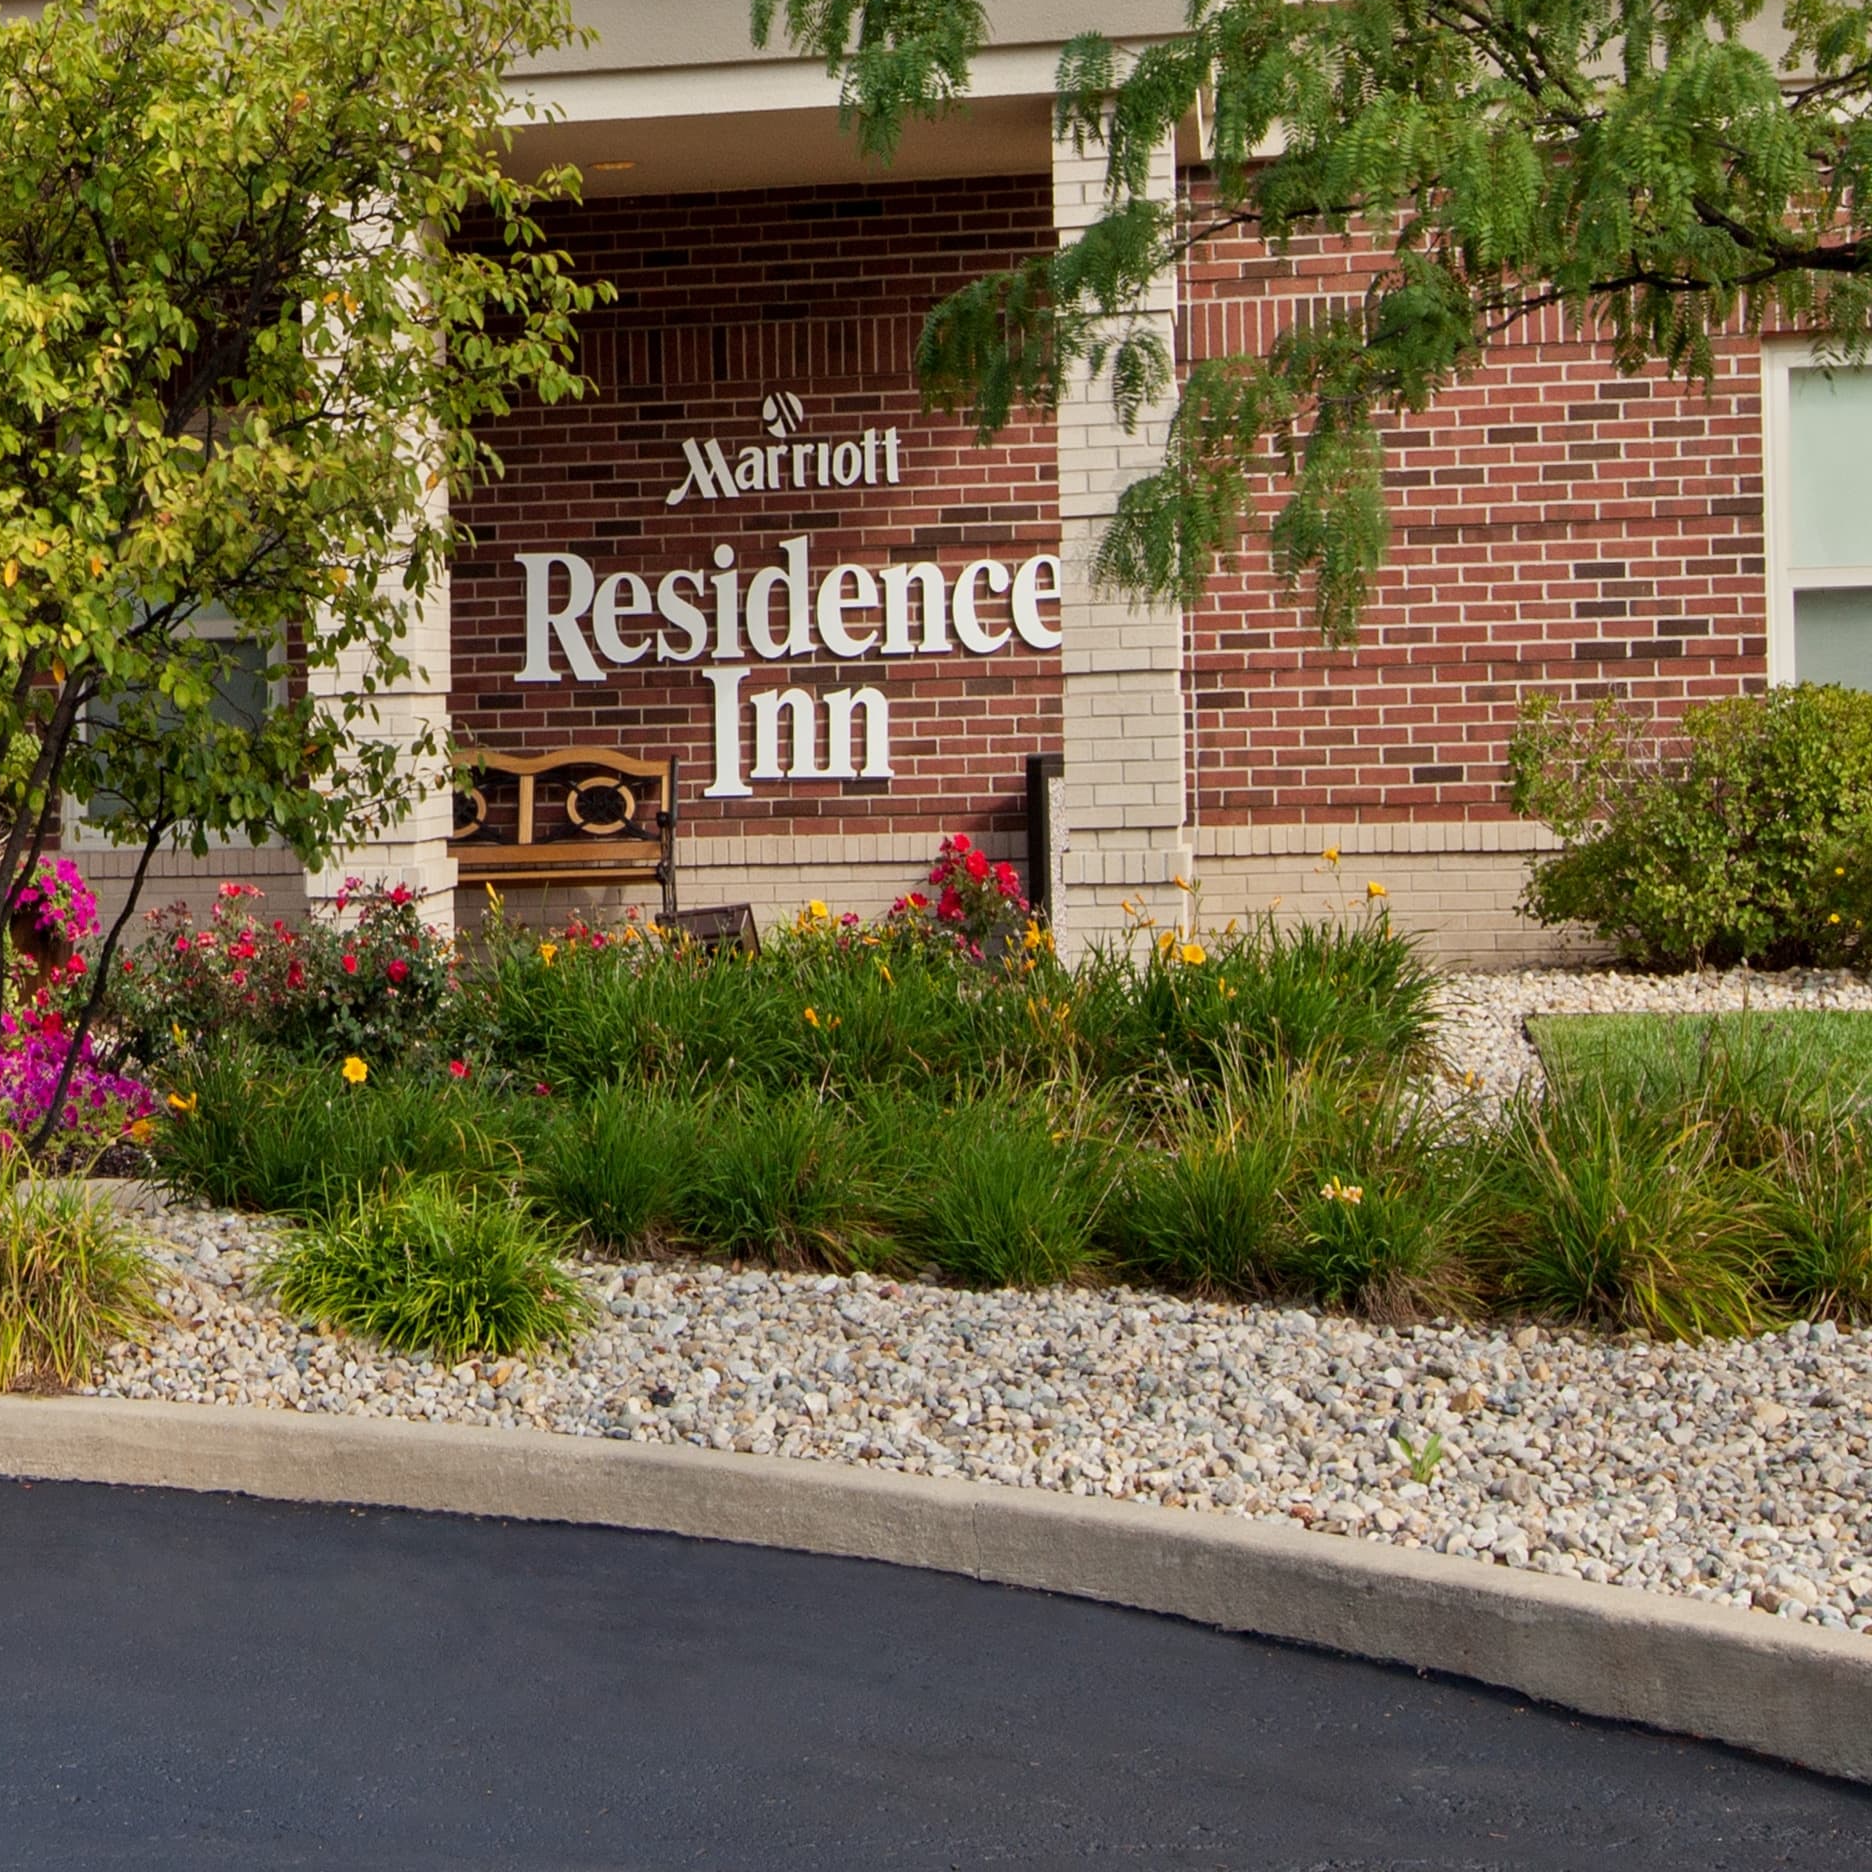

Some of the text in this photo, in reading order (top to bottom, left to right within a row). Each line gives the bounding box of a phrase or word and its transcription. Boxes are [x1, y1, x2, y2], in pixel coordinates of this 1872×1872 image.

[666, 426, 901, 505] Marriott
[514, 535, 1061, 681] Residence
[702, 667, 895, 797] Inn
